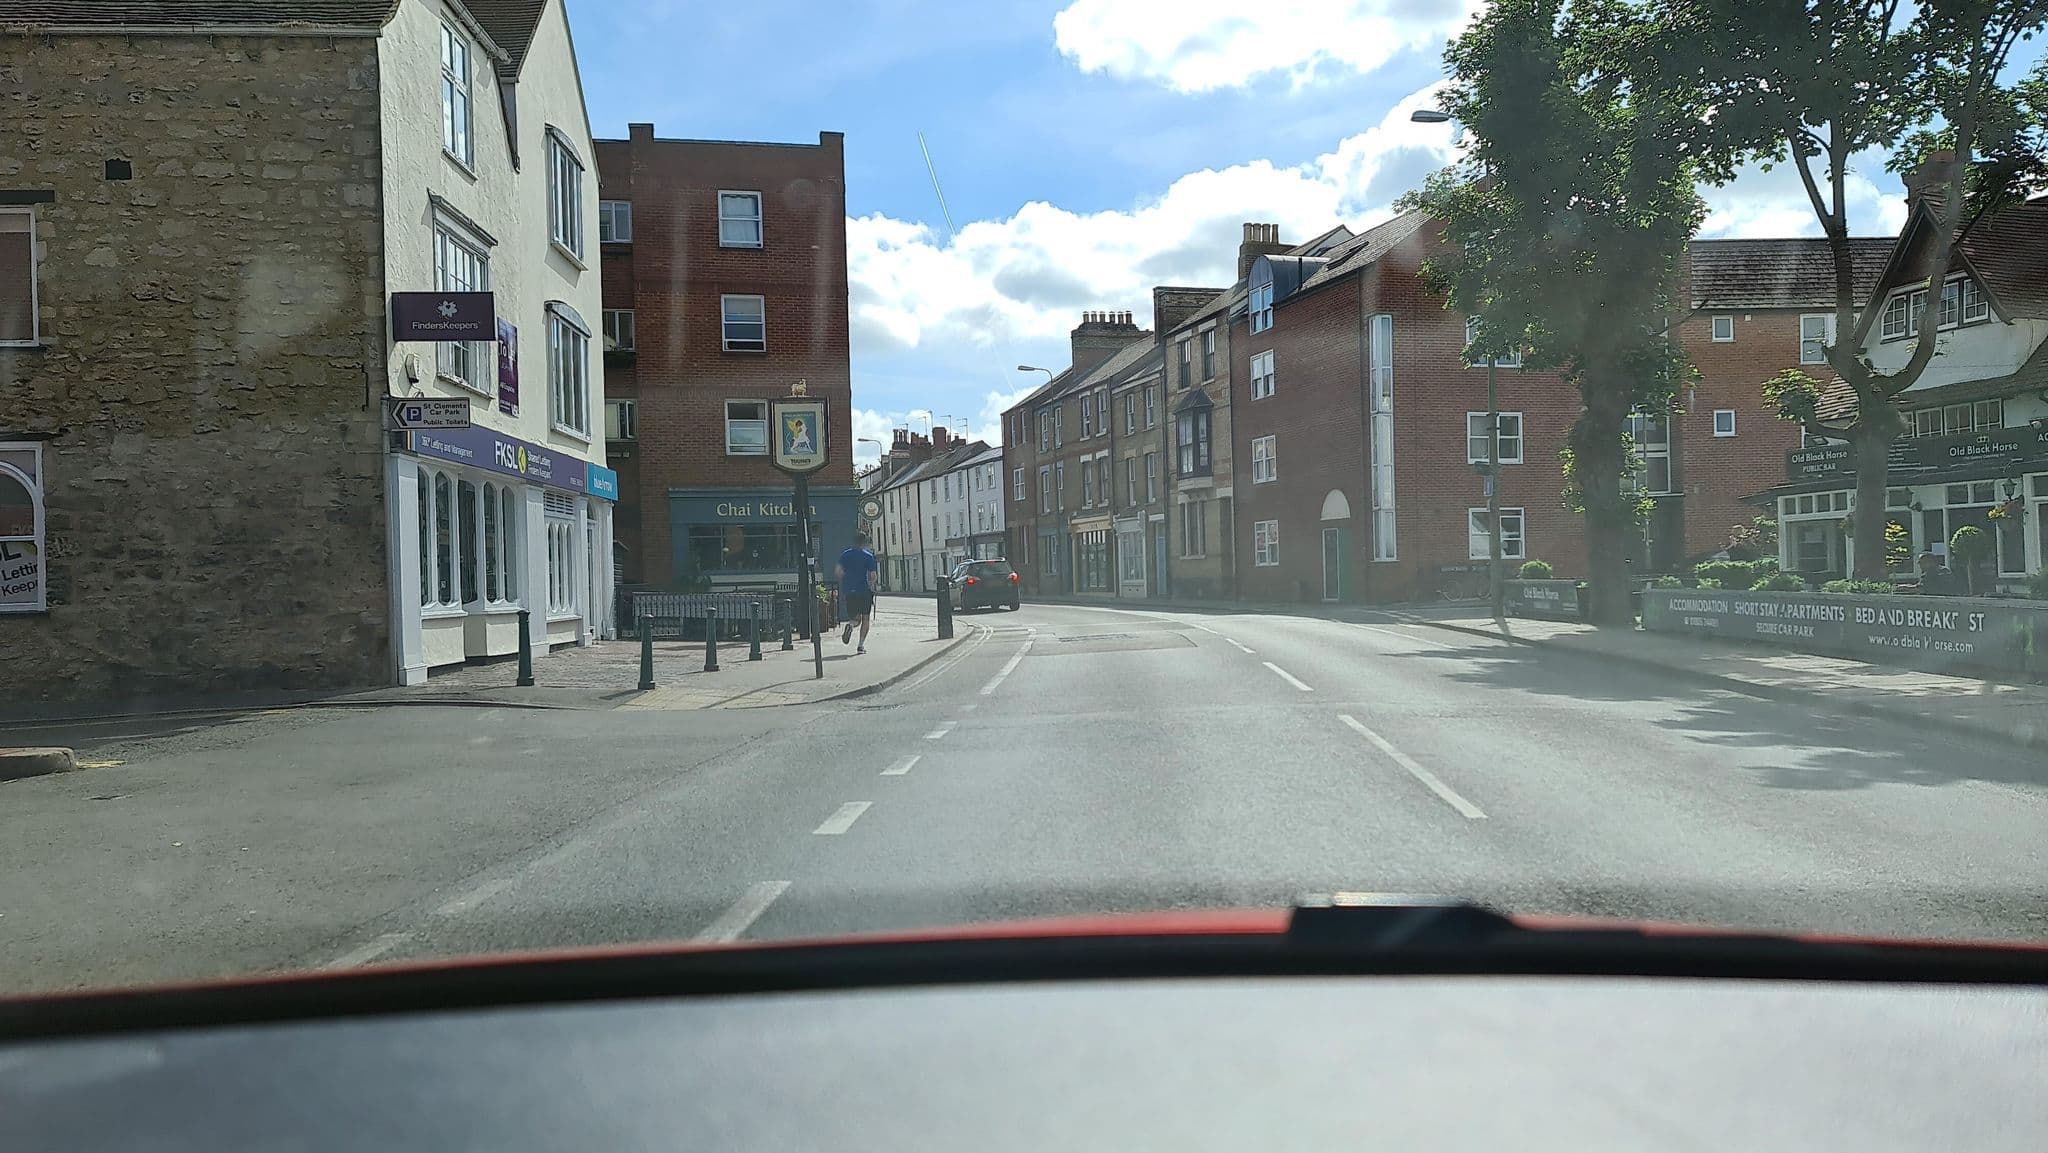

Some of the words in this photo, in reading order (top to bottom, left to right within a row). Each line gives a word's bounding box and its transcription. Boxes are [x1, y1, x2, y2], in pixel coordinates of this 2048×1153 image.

[412, 321, 480, 331] FindersKeepers
[495, 439, 518, 470] FKSL
[1791, 454, 1804, 464] Old
[1805, 452, 1825, 462] Black
[1826, 449, 1848, 459] Horse
[1950, 446, 1965, 457] Old
[1967, 444, 1990, 455] Black
[1992, 442, 2018, 452] Horse
[1802, 464, 1823, 473] PUBLIC
[1823, 462, 1836, 471] BAR
[716, 503, 751, 516] Chai
[759, 503, 816, 516] Kitchn
[1669, 598, 1728, 614] ACCOMMODATION
[1735, 601, 1759, 616] SHORT
[1759, 602, 1778, 617] STAY
[1855, 607, 1876, 623] BED
[1907, 610, 1985, 632] BREAKFST
[1793, 626, 1814, 638] PARK
